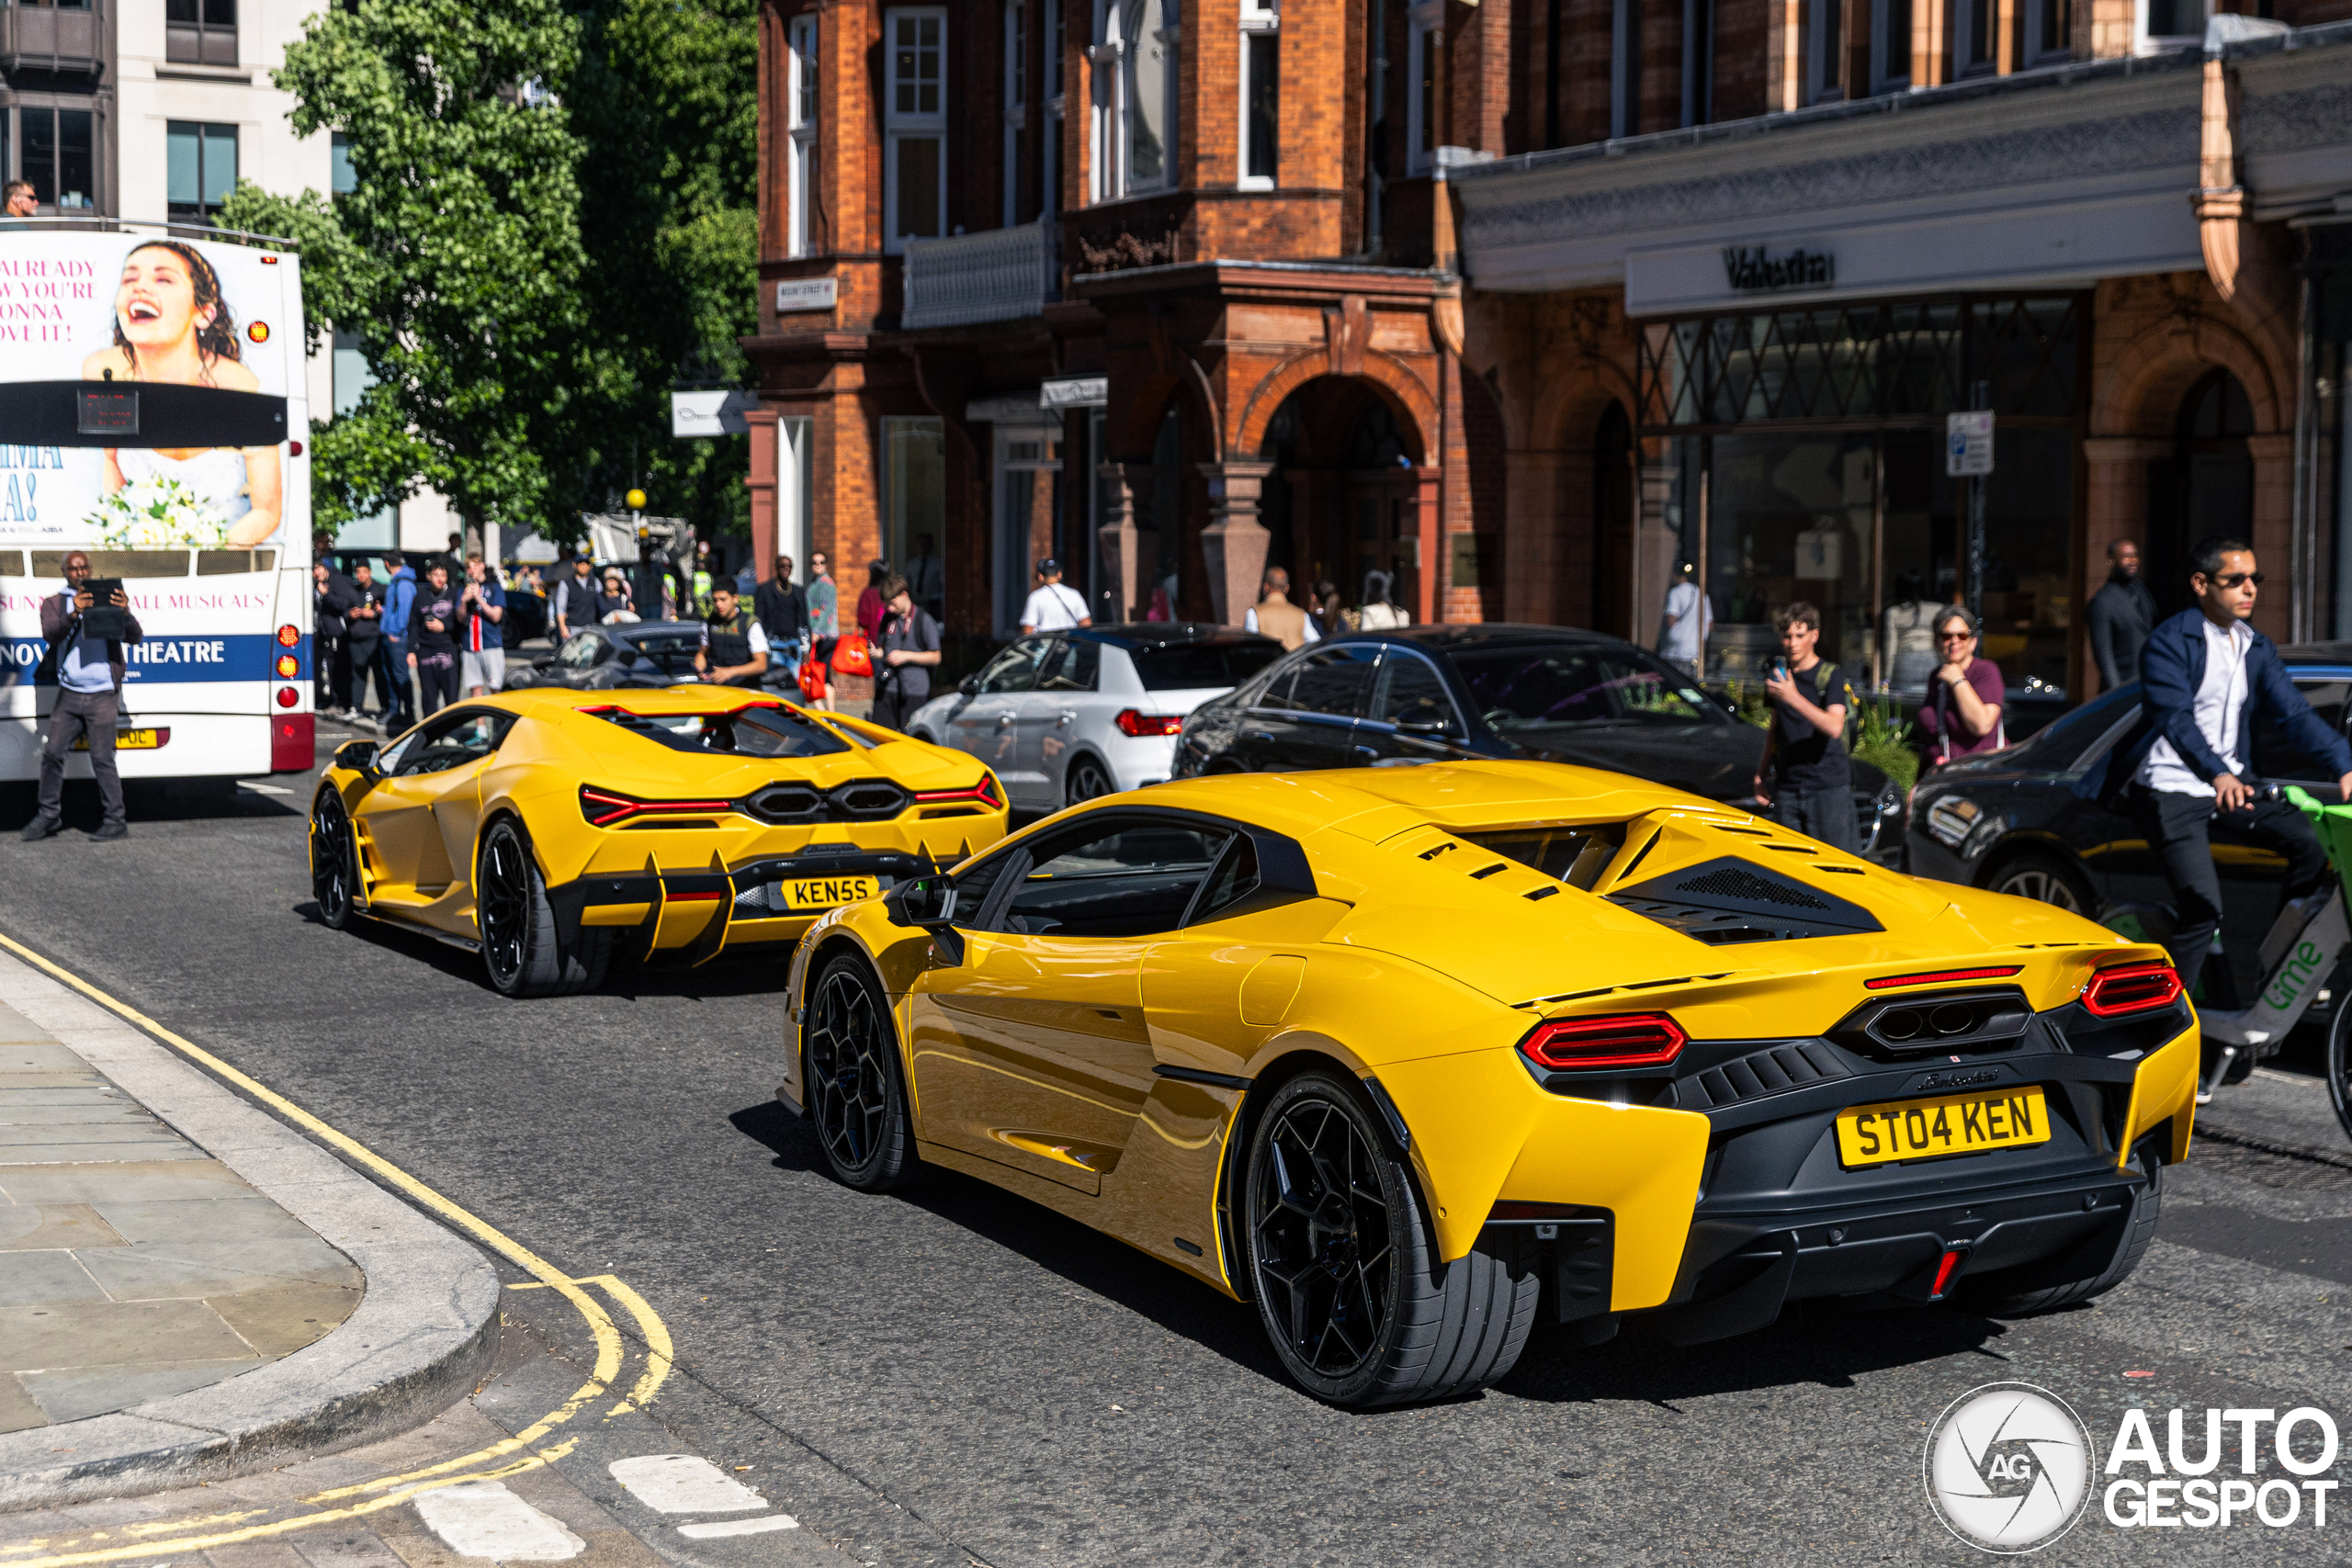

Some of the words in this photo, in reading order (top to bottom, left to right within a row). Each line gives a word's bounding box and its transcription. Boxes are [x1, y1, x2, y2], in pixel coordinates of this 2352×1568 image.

[0, 260, 96, 276] ALREADY
[21, 282, 98, 299] YOU'RE
[42, 324, 71, 342] IT!
[0, 472, 37, 522] A!
[122, 640, 225, 664] THEATRE
[795, 879, 868, 904] KEN5S
[1917, 1067, 1999, 1091] Lamborghini
[1961, 1096, 2034, 1144] KEN
